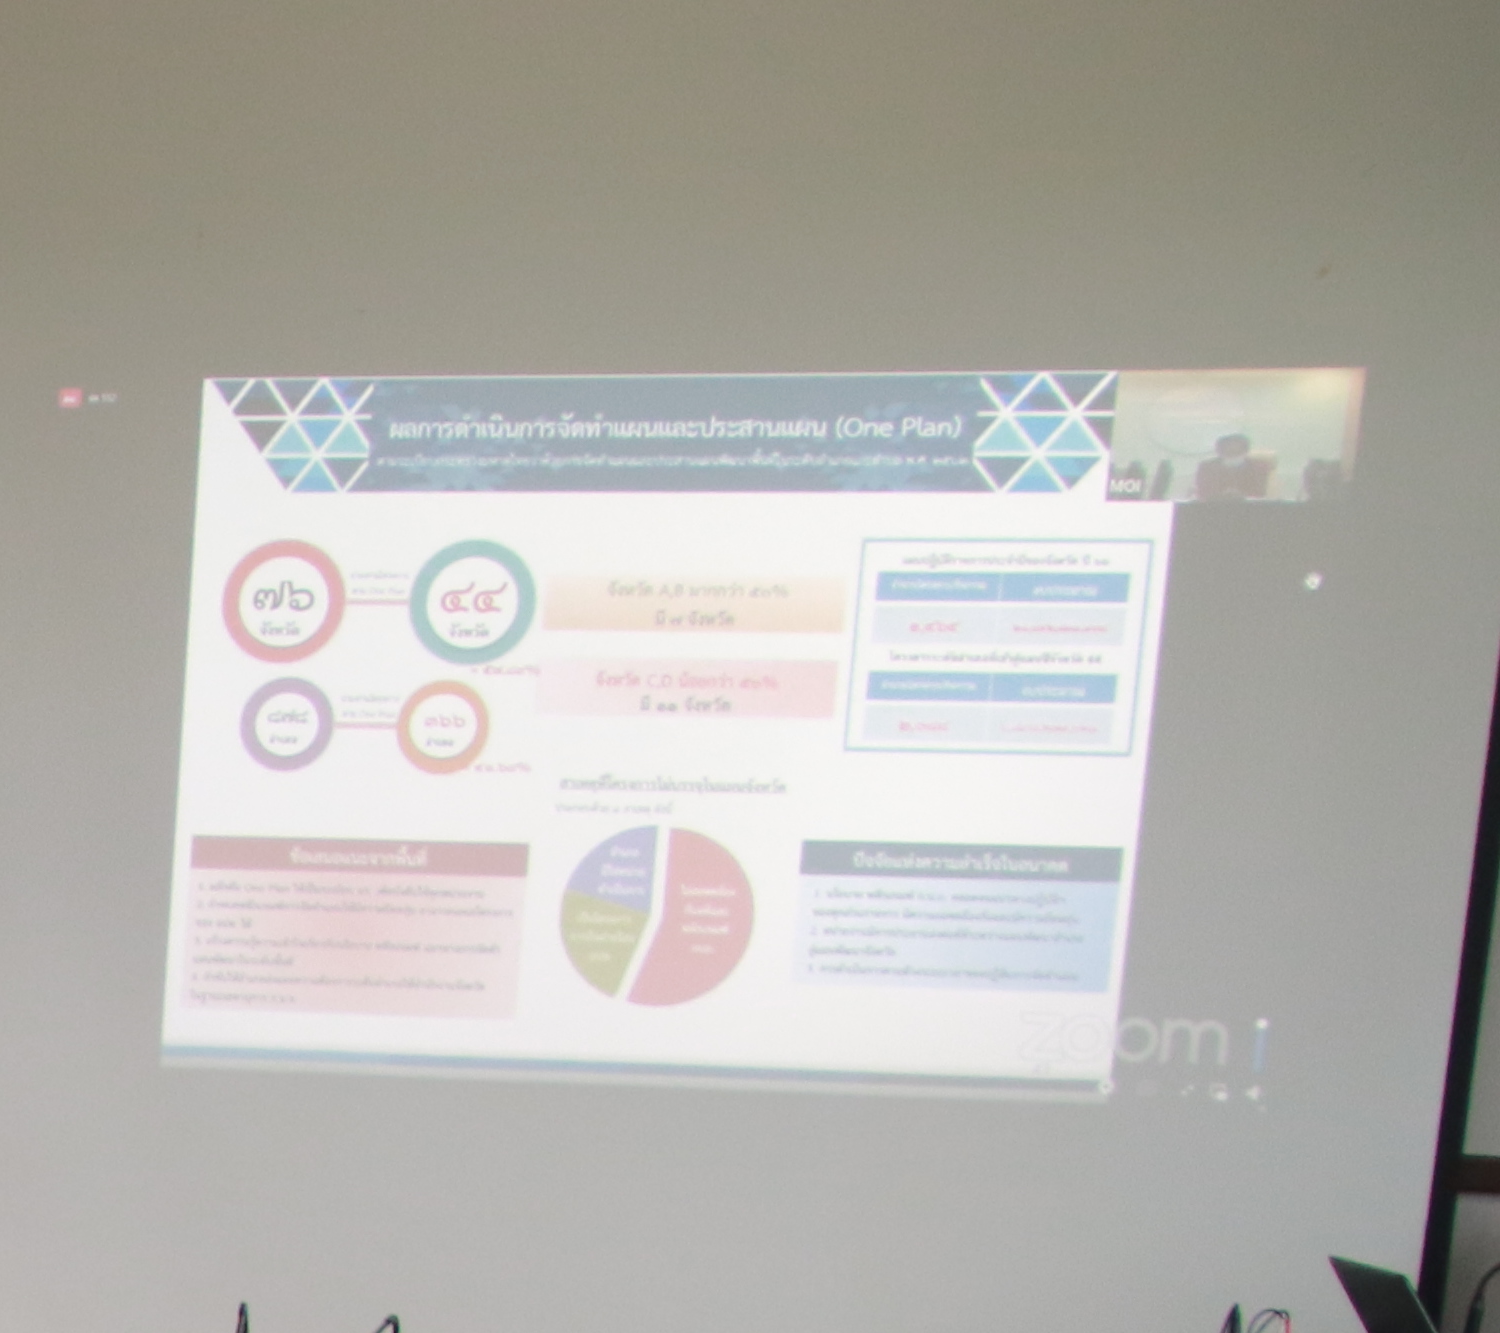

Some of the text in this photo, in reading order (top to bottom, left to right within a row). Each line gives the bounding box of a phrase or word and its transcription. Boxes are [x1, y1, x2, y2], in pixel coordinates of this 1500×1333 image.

[389, 411, 962, 438] ผลการดำเนินการจัดทำแผนและประสานแผน (One Plan)
[1111, 480, 1140, 492] MOI
[253, 580, 315, 611] ๗๖
[441, 582, 508, 613] ๔๔
[260, 621, 300, 636] จังหวัด
[450, 623, 490, 638] จังหวัด
